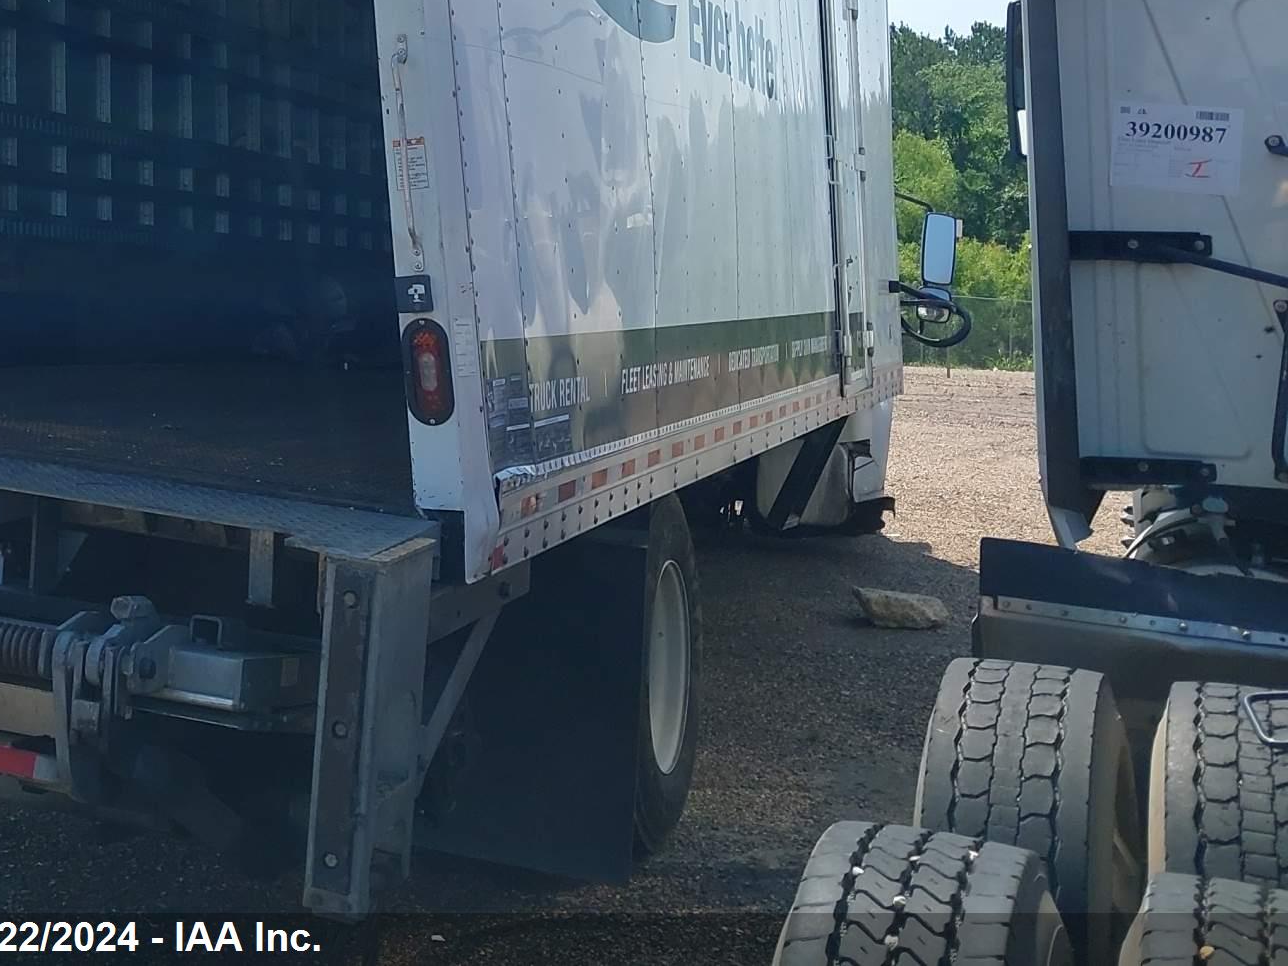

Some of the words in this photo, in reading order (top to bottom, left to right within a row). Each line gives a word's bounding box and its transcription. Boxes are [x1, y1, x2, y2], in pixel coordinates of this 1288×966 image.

[1125, 121, 1227, 144] 39200987
[621, 366, 641, 395] FLEET
[642, 363, 667, 391] LEASING
[674, 355, 710, 384] MAINTENANCE
[528, 380, 558, 414] TRUCK
[559, 376, 591, 408] RENTAL
